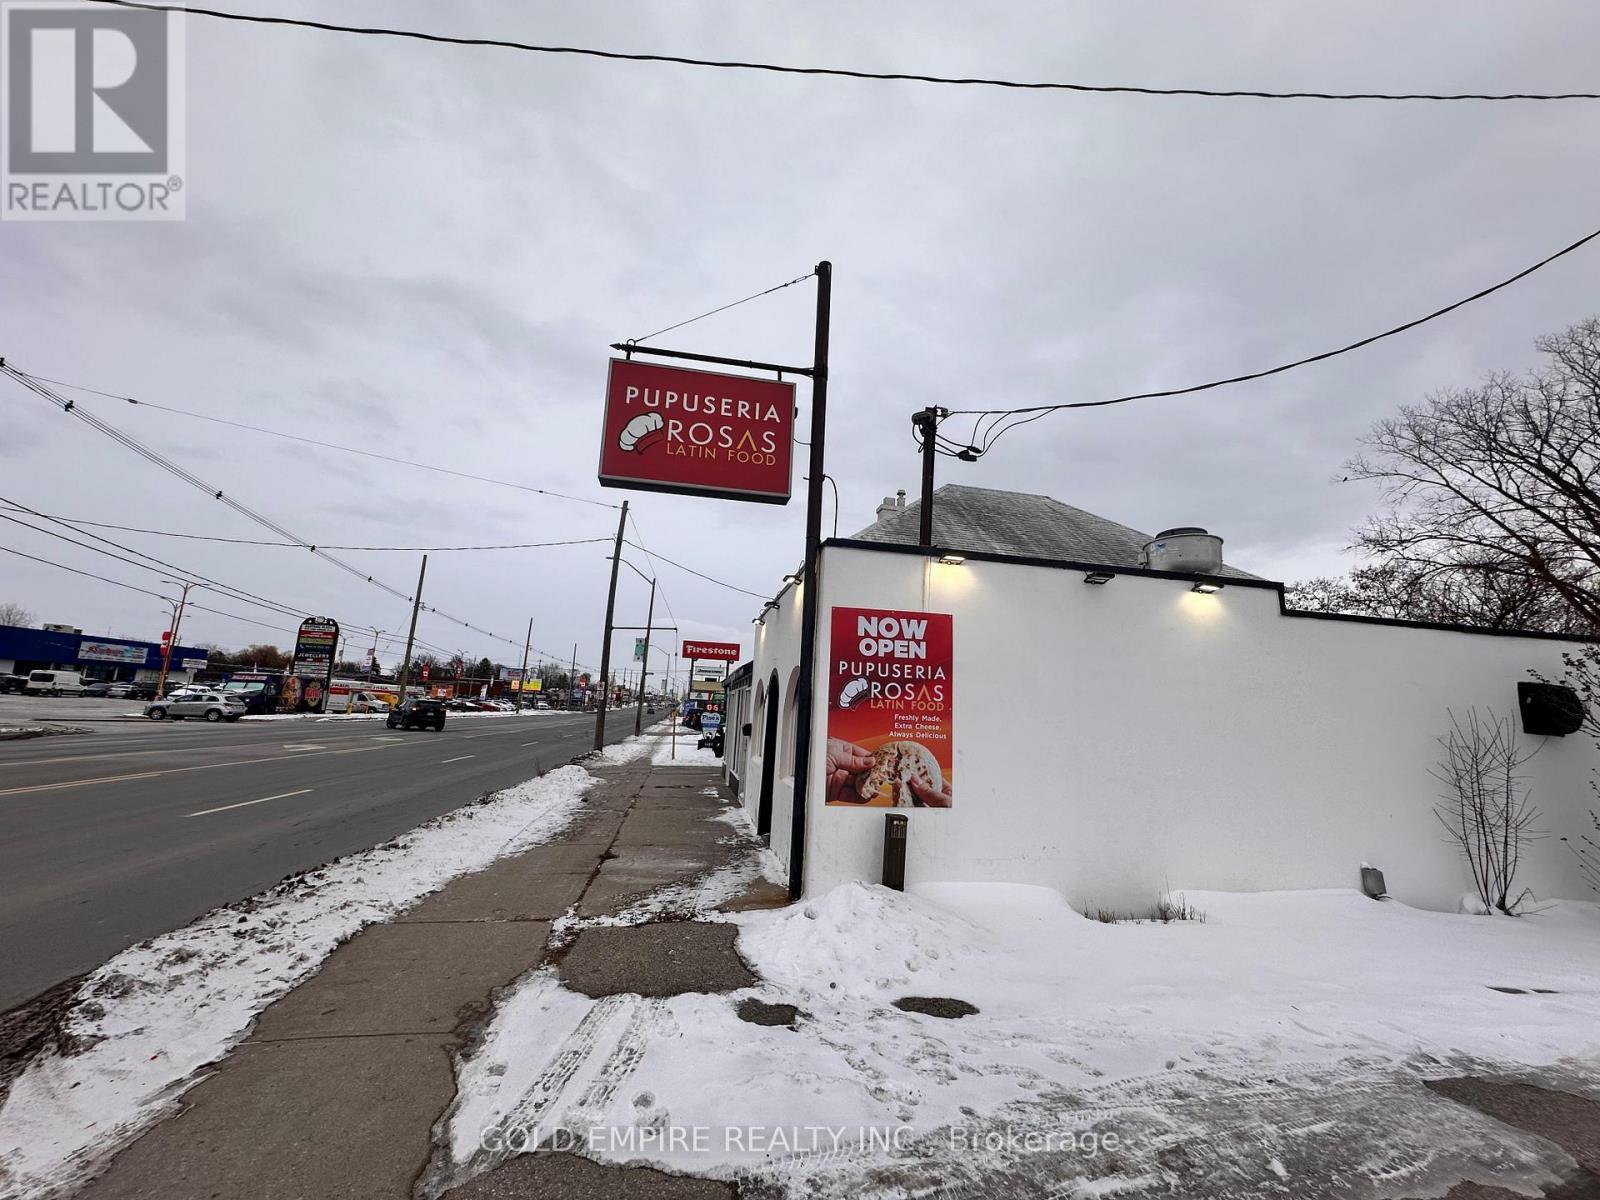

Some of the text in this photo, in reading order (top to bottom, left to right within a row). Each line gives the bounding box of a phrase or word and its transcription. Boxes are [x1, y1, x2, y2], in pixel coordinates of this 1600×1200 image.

[626, 386, 781, 423] PUPUSERIA
[668, 419, 776, 454] ROSAS
[666, 443, 776, 466] LATIN FOOD
[858, 616, 928, 640] NOW
[686, 645, 737, 656] Firestone
[859, 638, 926, 660] OPEN
[839, 660, 946, 680] PUPUSERIA
[870, 682, 944, 702] ROSAS
[870, 700, 944, 711] LATIN FOOD
[895, 714, 918, 722] Freshly
